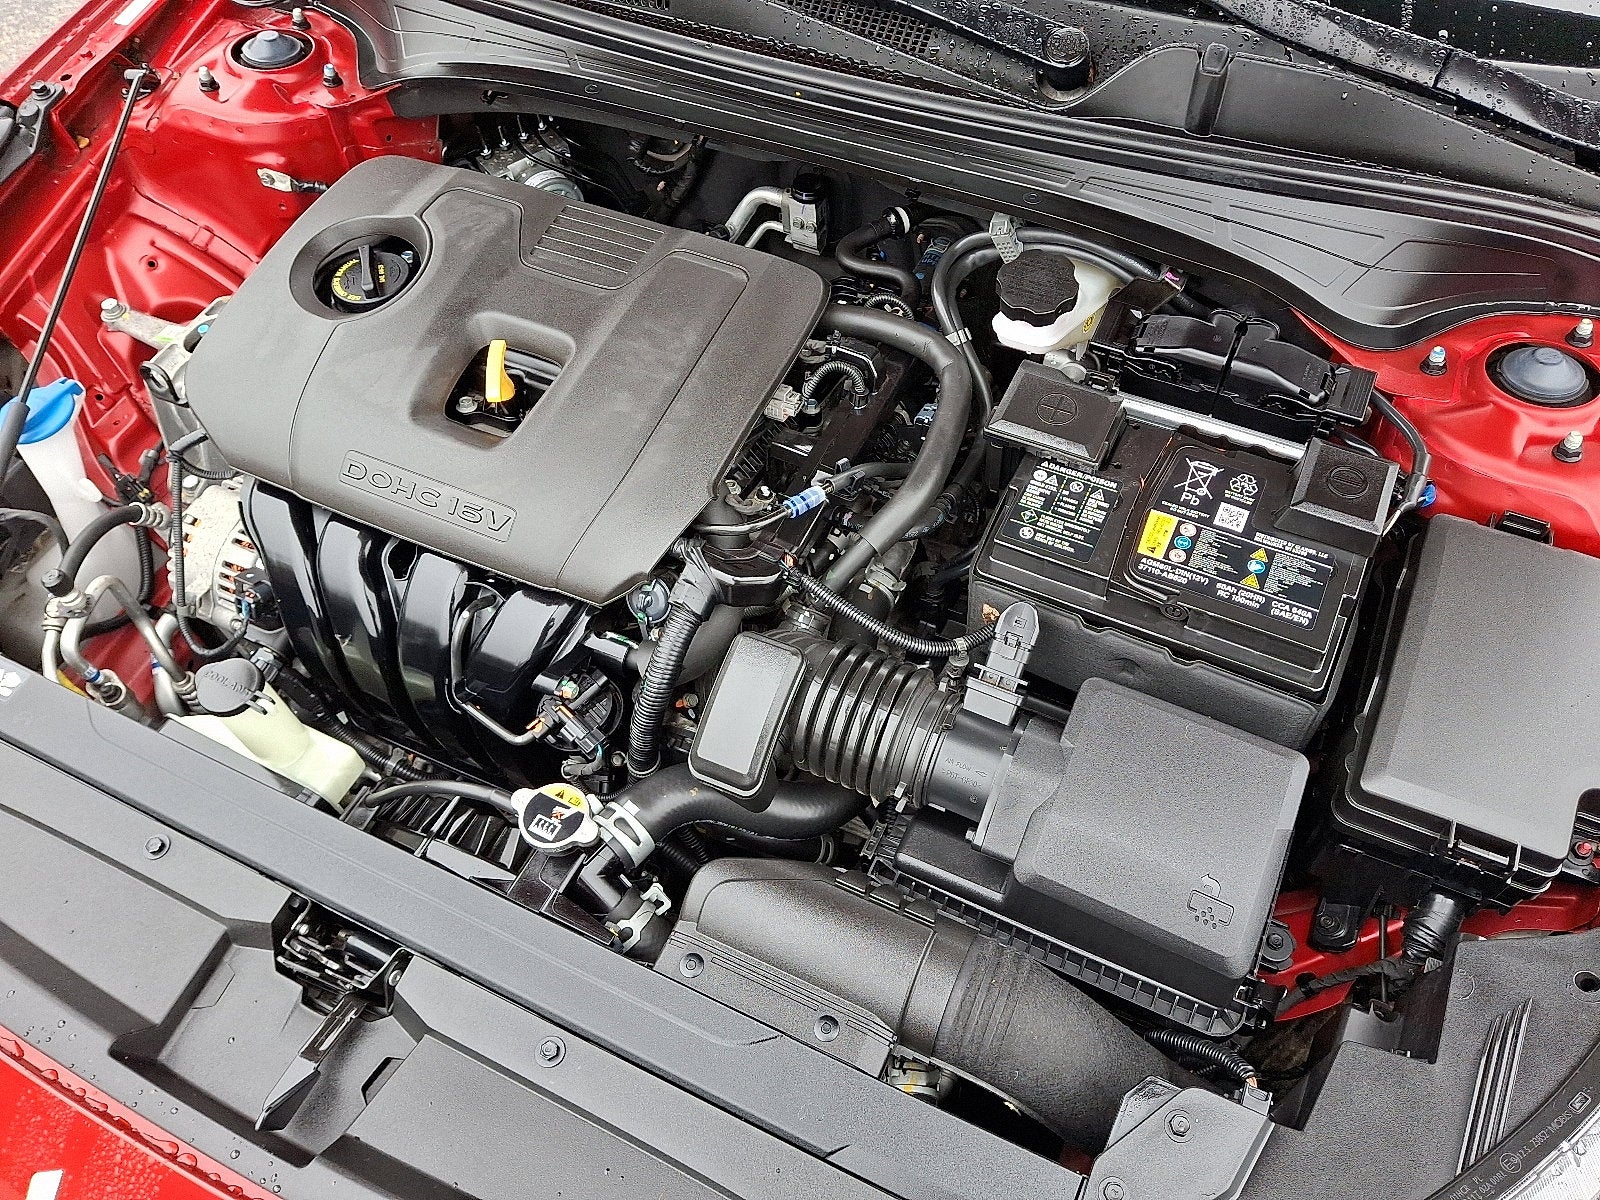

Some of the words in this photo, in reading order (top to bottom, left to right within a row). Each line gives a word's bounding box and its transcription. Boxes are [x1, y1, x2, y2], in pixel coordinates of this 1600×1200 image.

[1049, 463, 1118, 489] DANGER/POISON
[342, 457, 442, 508] DOHC
[448, 496, 512, 532] 16V
[1180, 492, 1200, 506] Pb
[1232, 594, 1260, 609] 100min
[1272, 600, 1290, 612] CCA
[1270, 608, 1310, 626] (SAE/EN)
